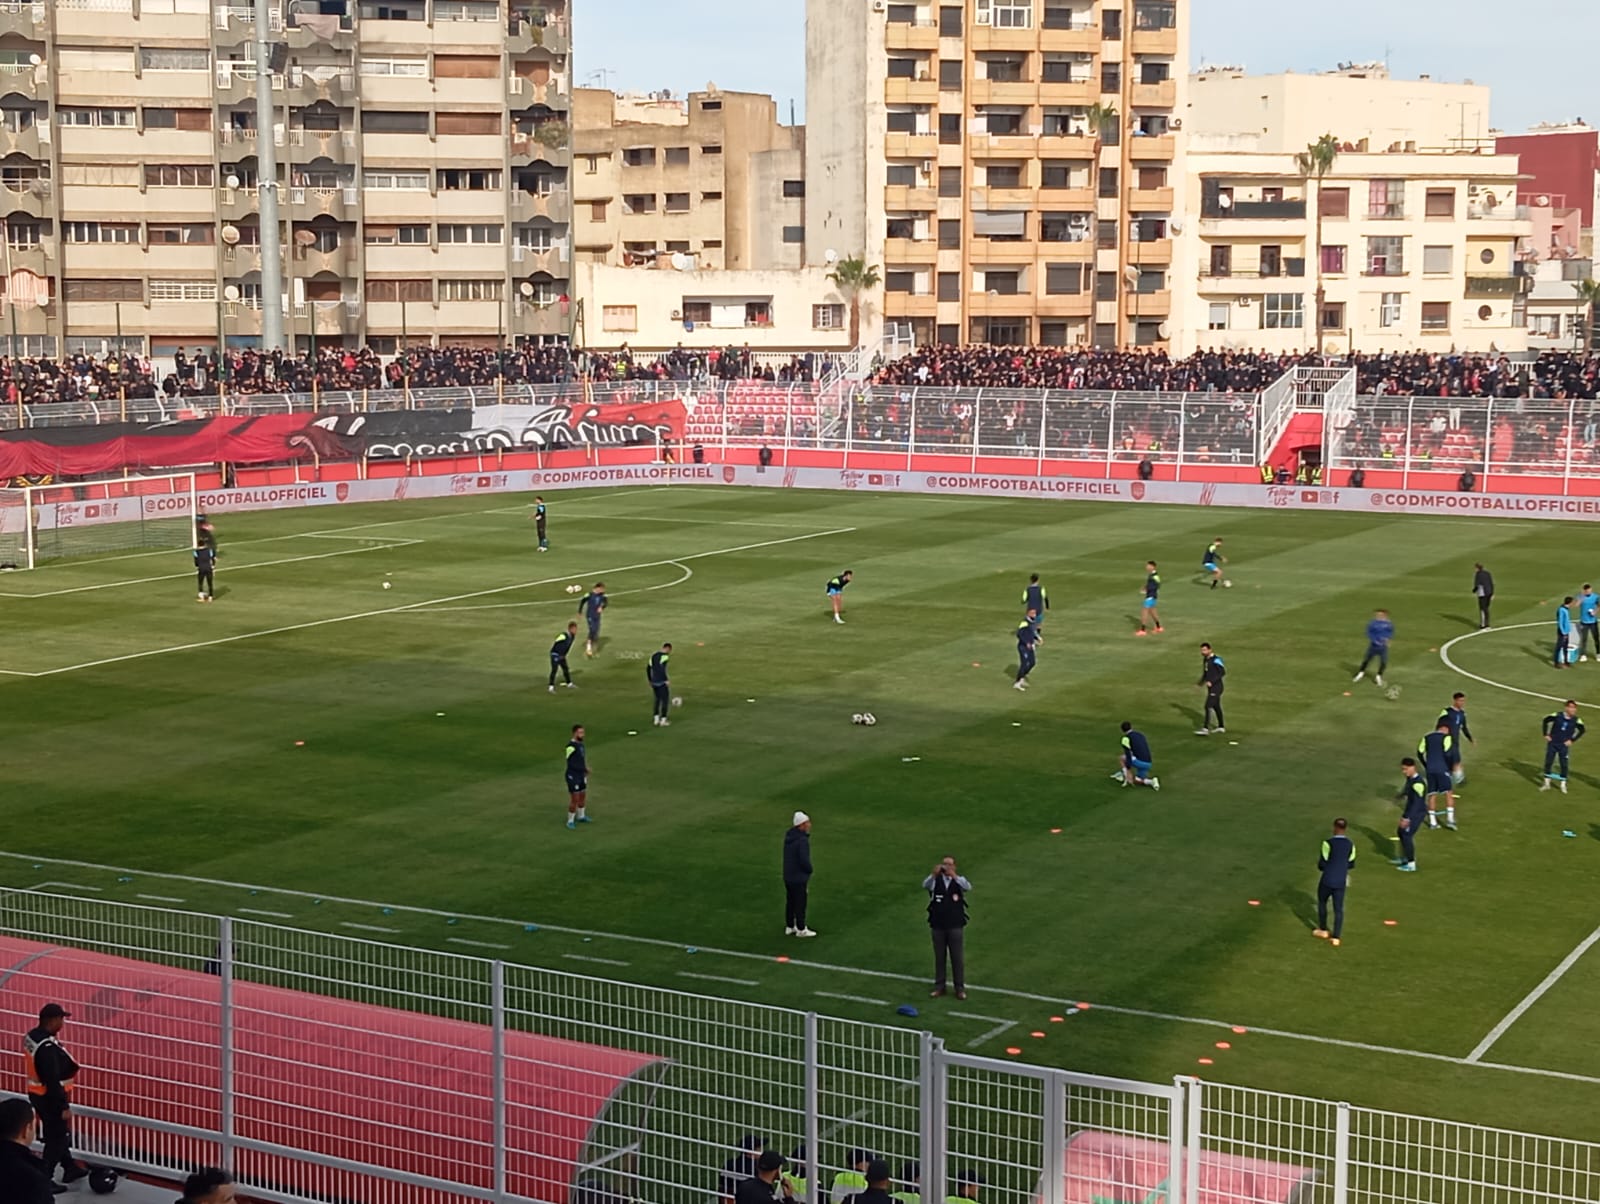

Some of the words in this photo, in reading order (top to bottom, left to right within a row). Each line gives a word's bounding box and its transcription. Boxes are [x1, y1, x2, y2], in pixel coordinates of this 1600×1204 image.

[532, 467, 714, 484] @CODMFOOTBALLOFFICIEL
[926, 476, 1121, 495] @CODMFOOTBALLOFFICIEL
[1370, 493, 1600, 514] @CODMFOOTBALLOFFICIEL
